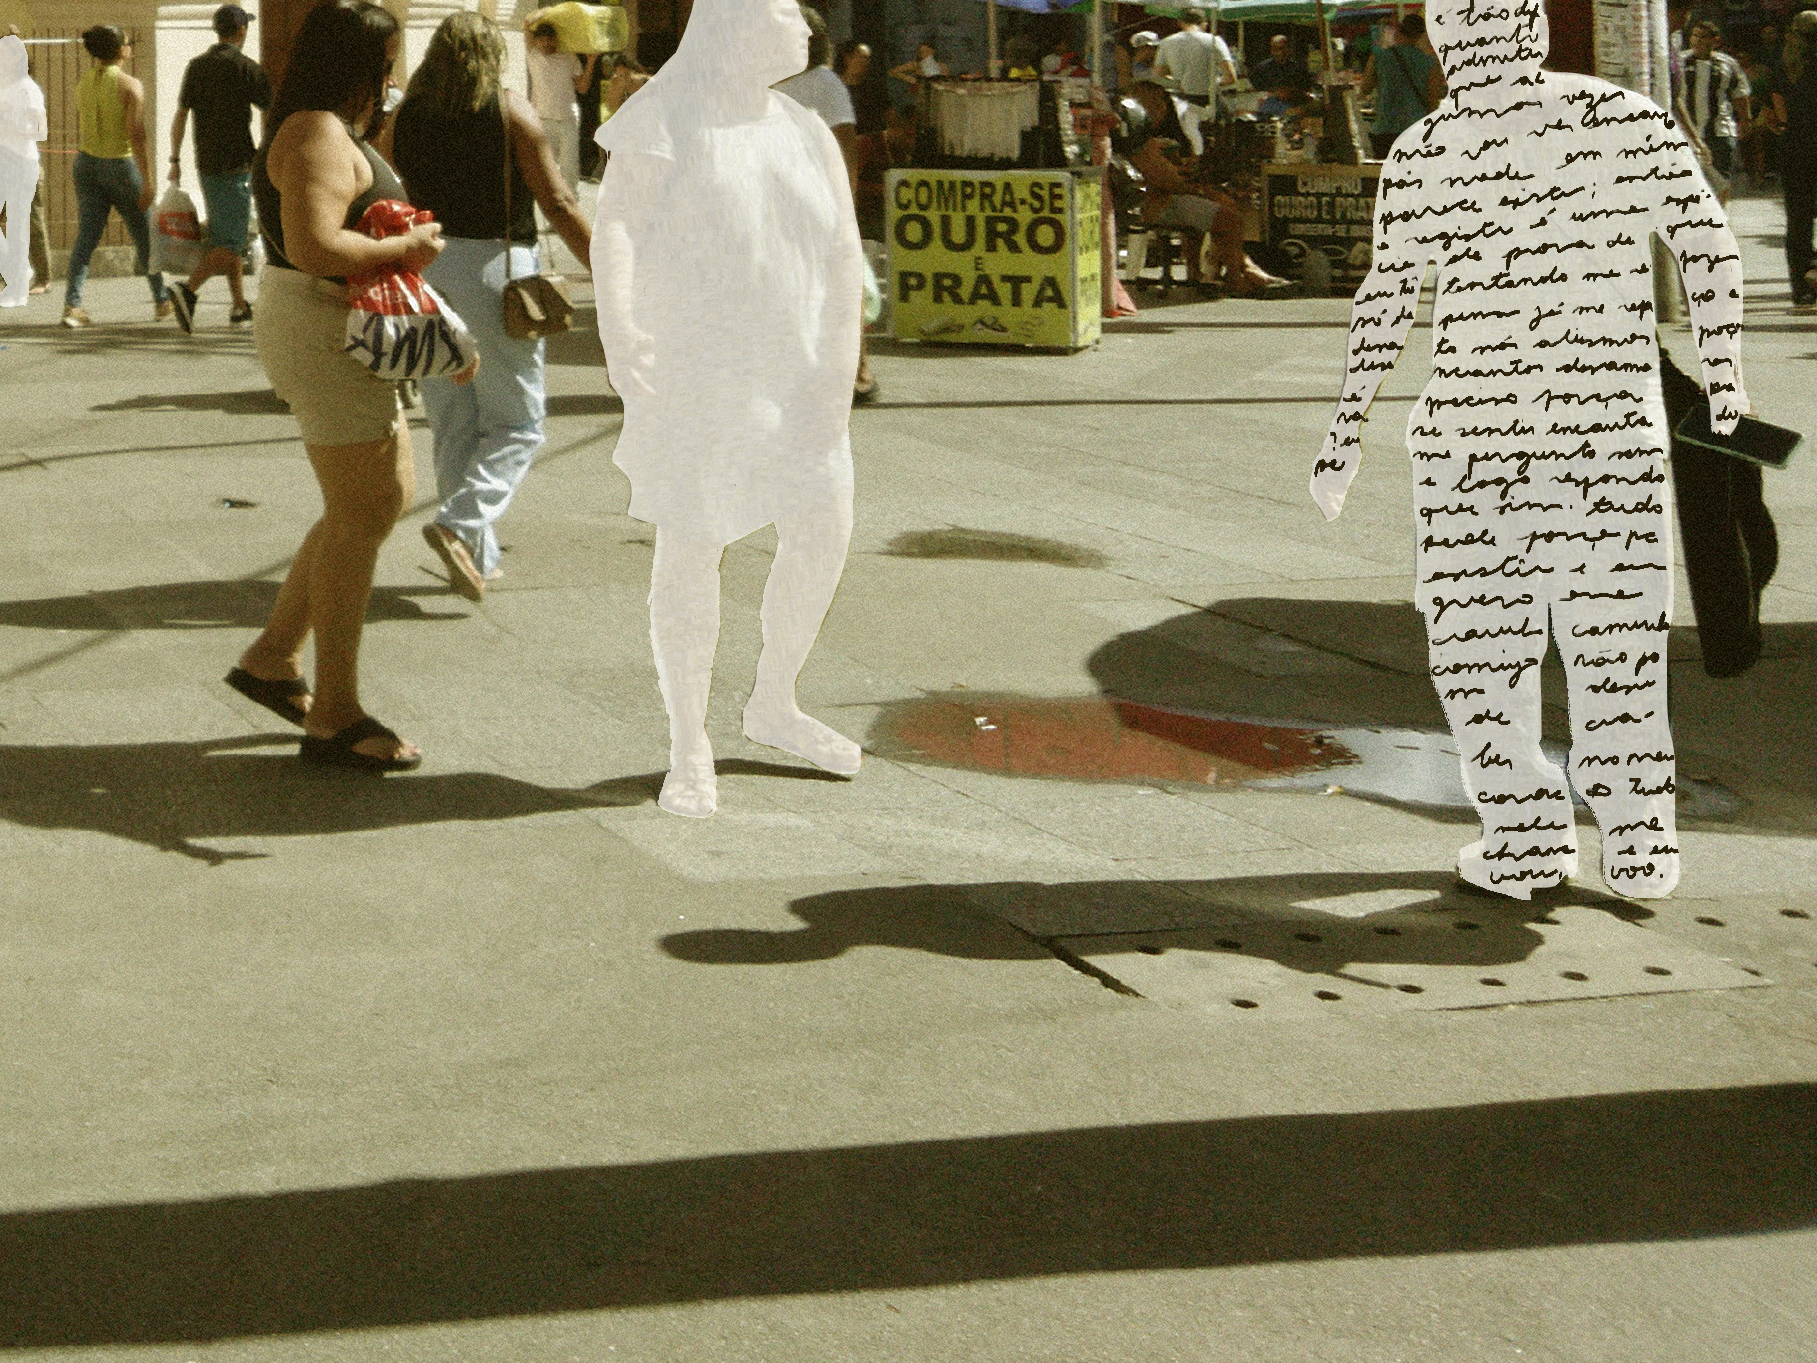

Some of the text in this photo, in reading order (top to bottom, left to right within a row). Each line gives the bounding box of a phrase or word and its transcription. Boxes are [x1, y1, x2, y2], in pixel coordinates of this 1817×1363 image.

[894, 179, 1065, 215] COMPRA-SE
[894, 213, 1066, 256] OURO
[975, 256, 983, 271] E
[898, 271, 1067, 309] PRATA
